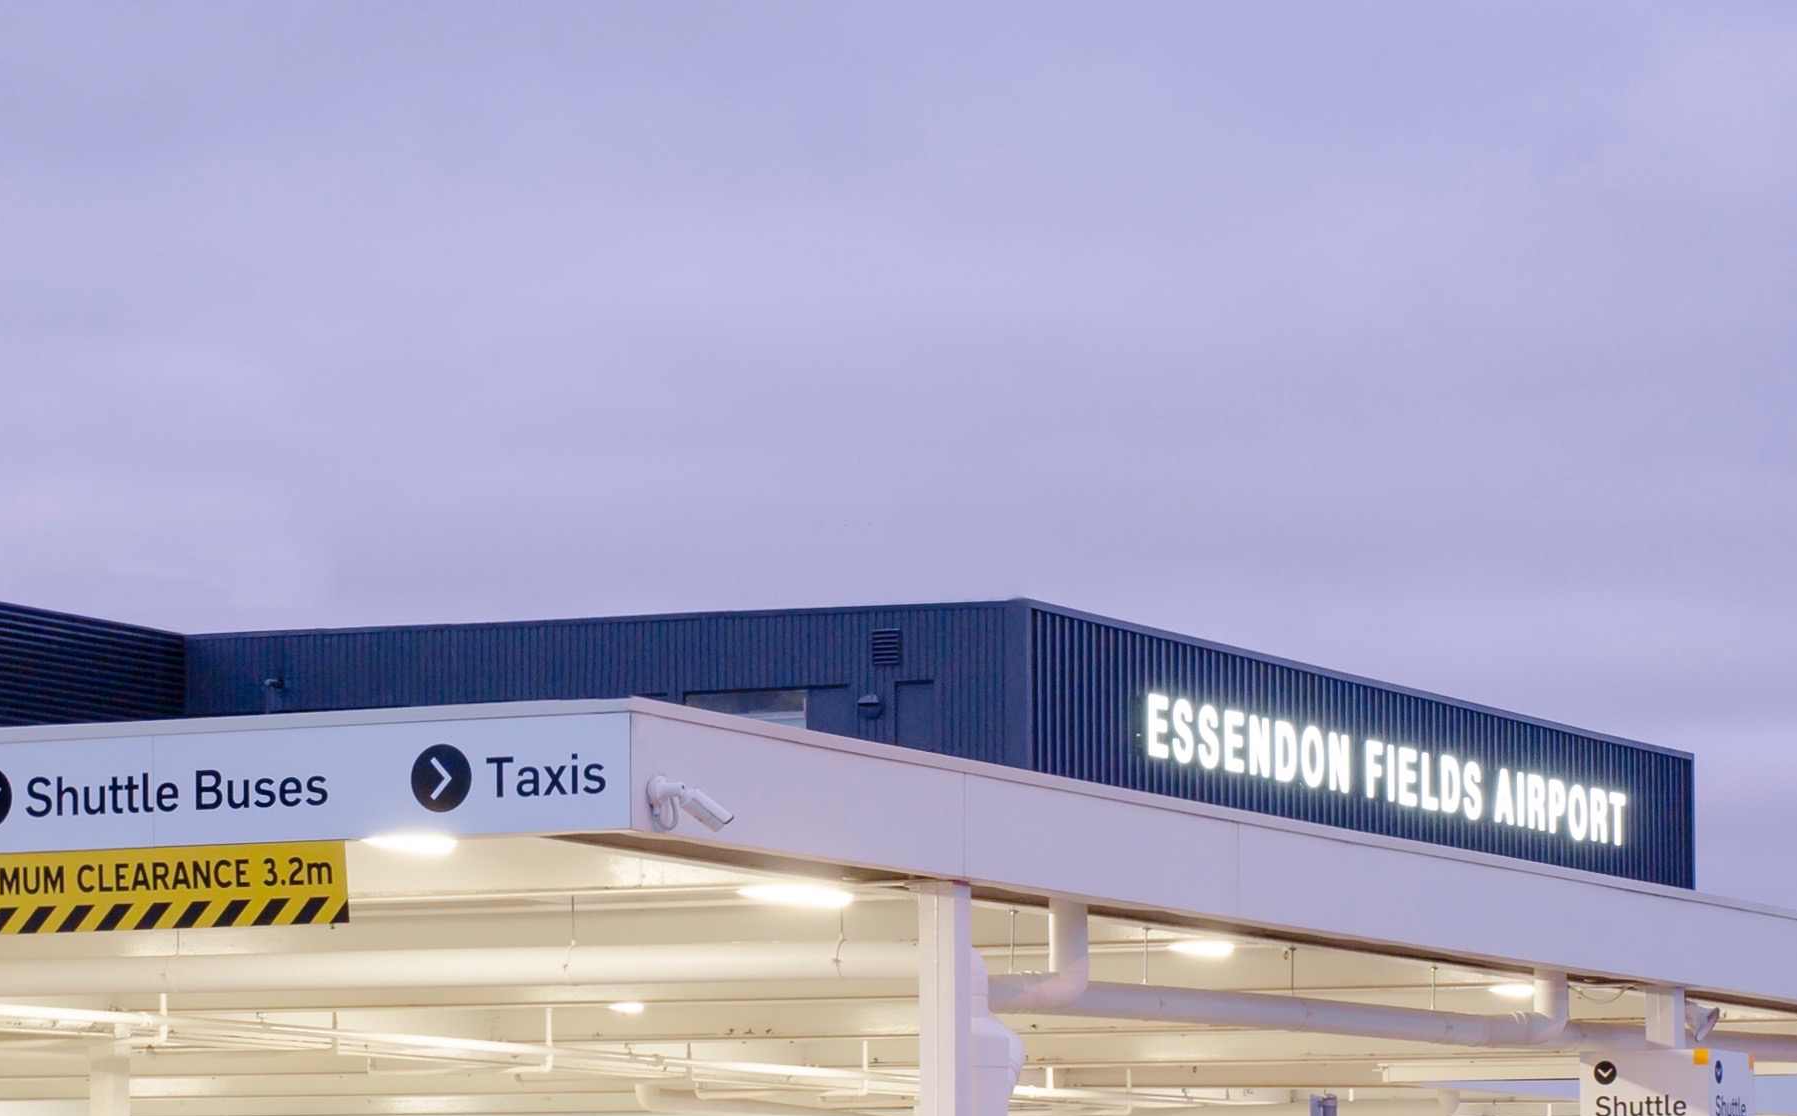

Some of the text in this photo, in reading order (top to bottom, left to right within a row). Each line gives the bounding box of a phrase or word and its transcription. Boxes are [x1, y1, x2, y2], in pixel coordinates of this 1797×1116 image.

[25, 769, 329, 818] Shuttle Buses
[486, 754, 607, 799] Taxis
[1146, 693, 1628, 848] ESSENDON FIELDS AIRPORT
[76, 857, 251, 894] CLEARANCE
[262, 856, 334, 889] 3.2m
